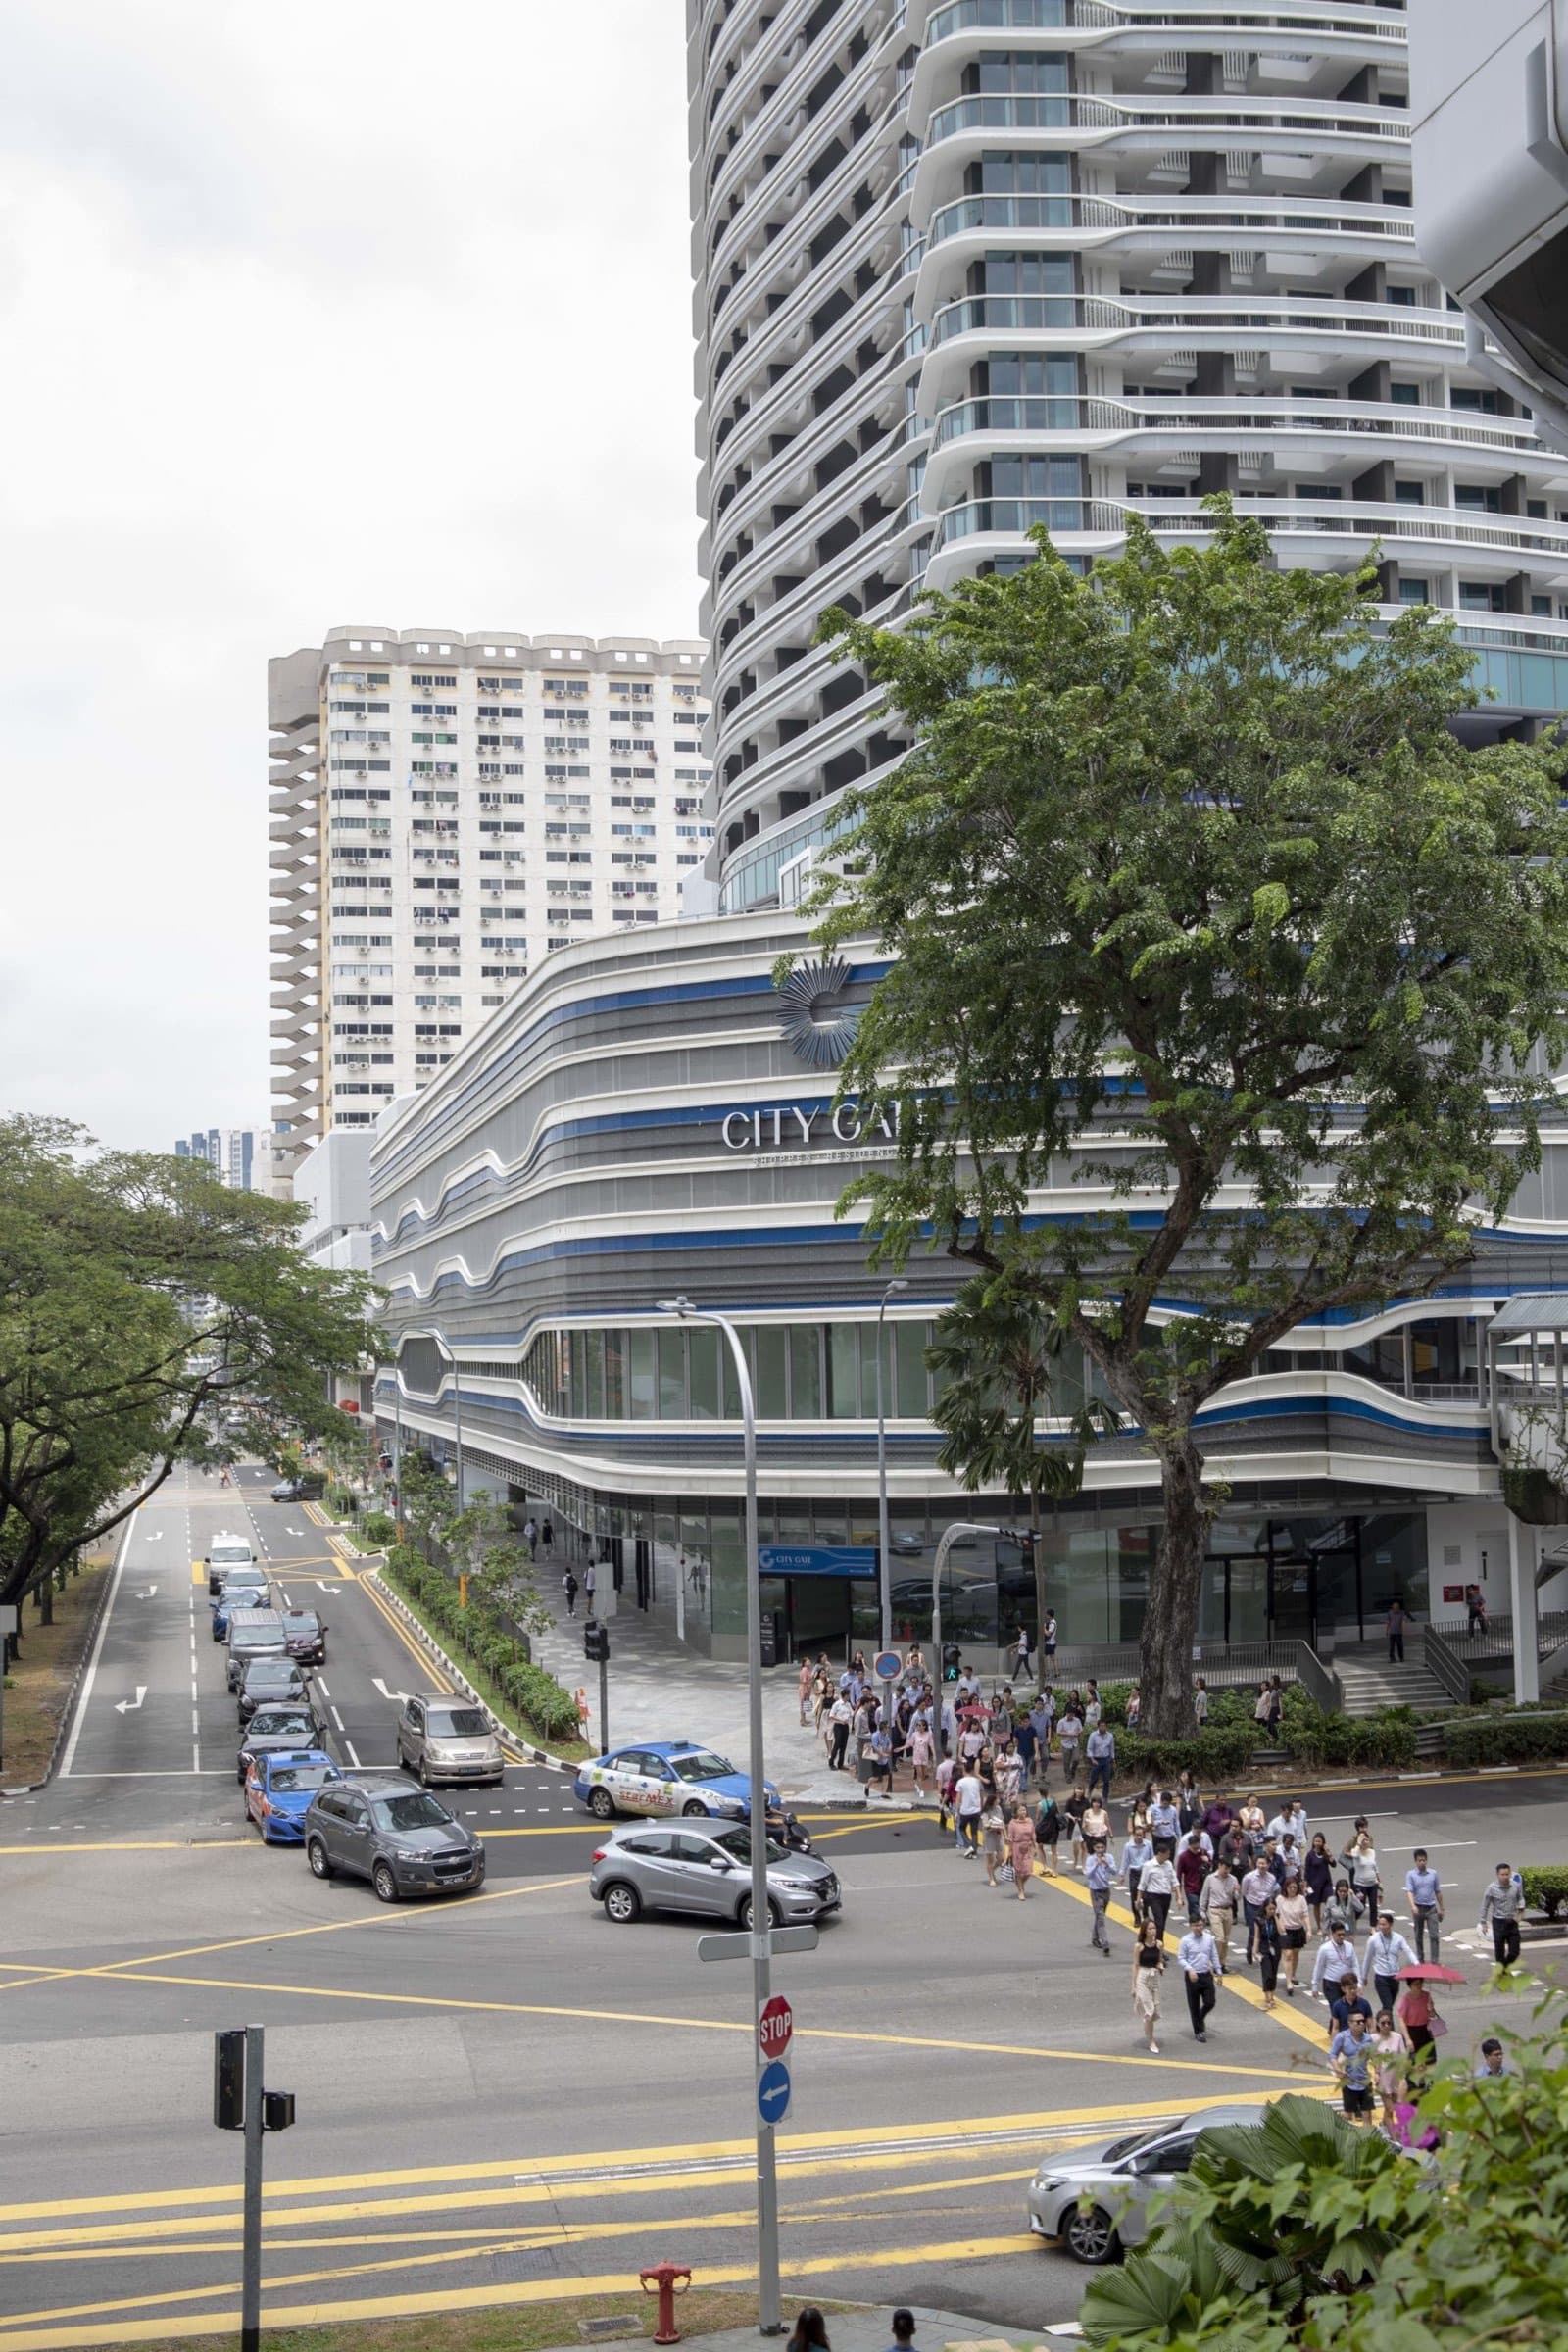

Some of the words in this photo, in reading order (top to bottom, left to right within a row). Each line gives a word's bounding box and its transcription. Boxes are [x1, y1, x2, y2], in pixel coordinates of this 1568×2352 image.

[722, 1105, 820, 1149] CITY
[827, 1148, 899, 1161] RESIDENC
[776, 1555, 792, 1564] CITY
[795, 1555, 812, 1564] GATE
[761, 2011, 791, 2043] STOP
